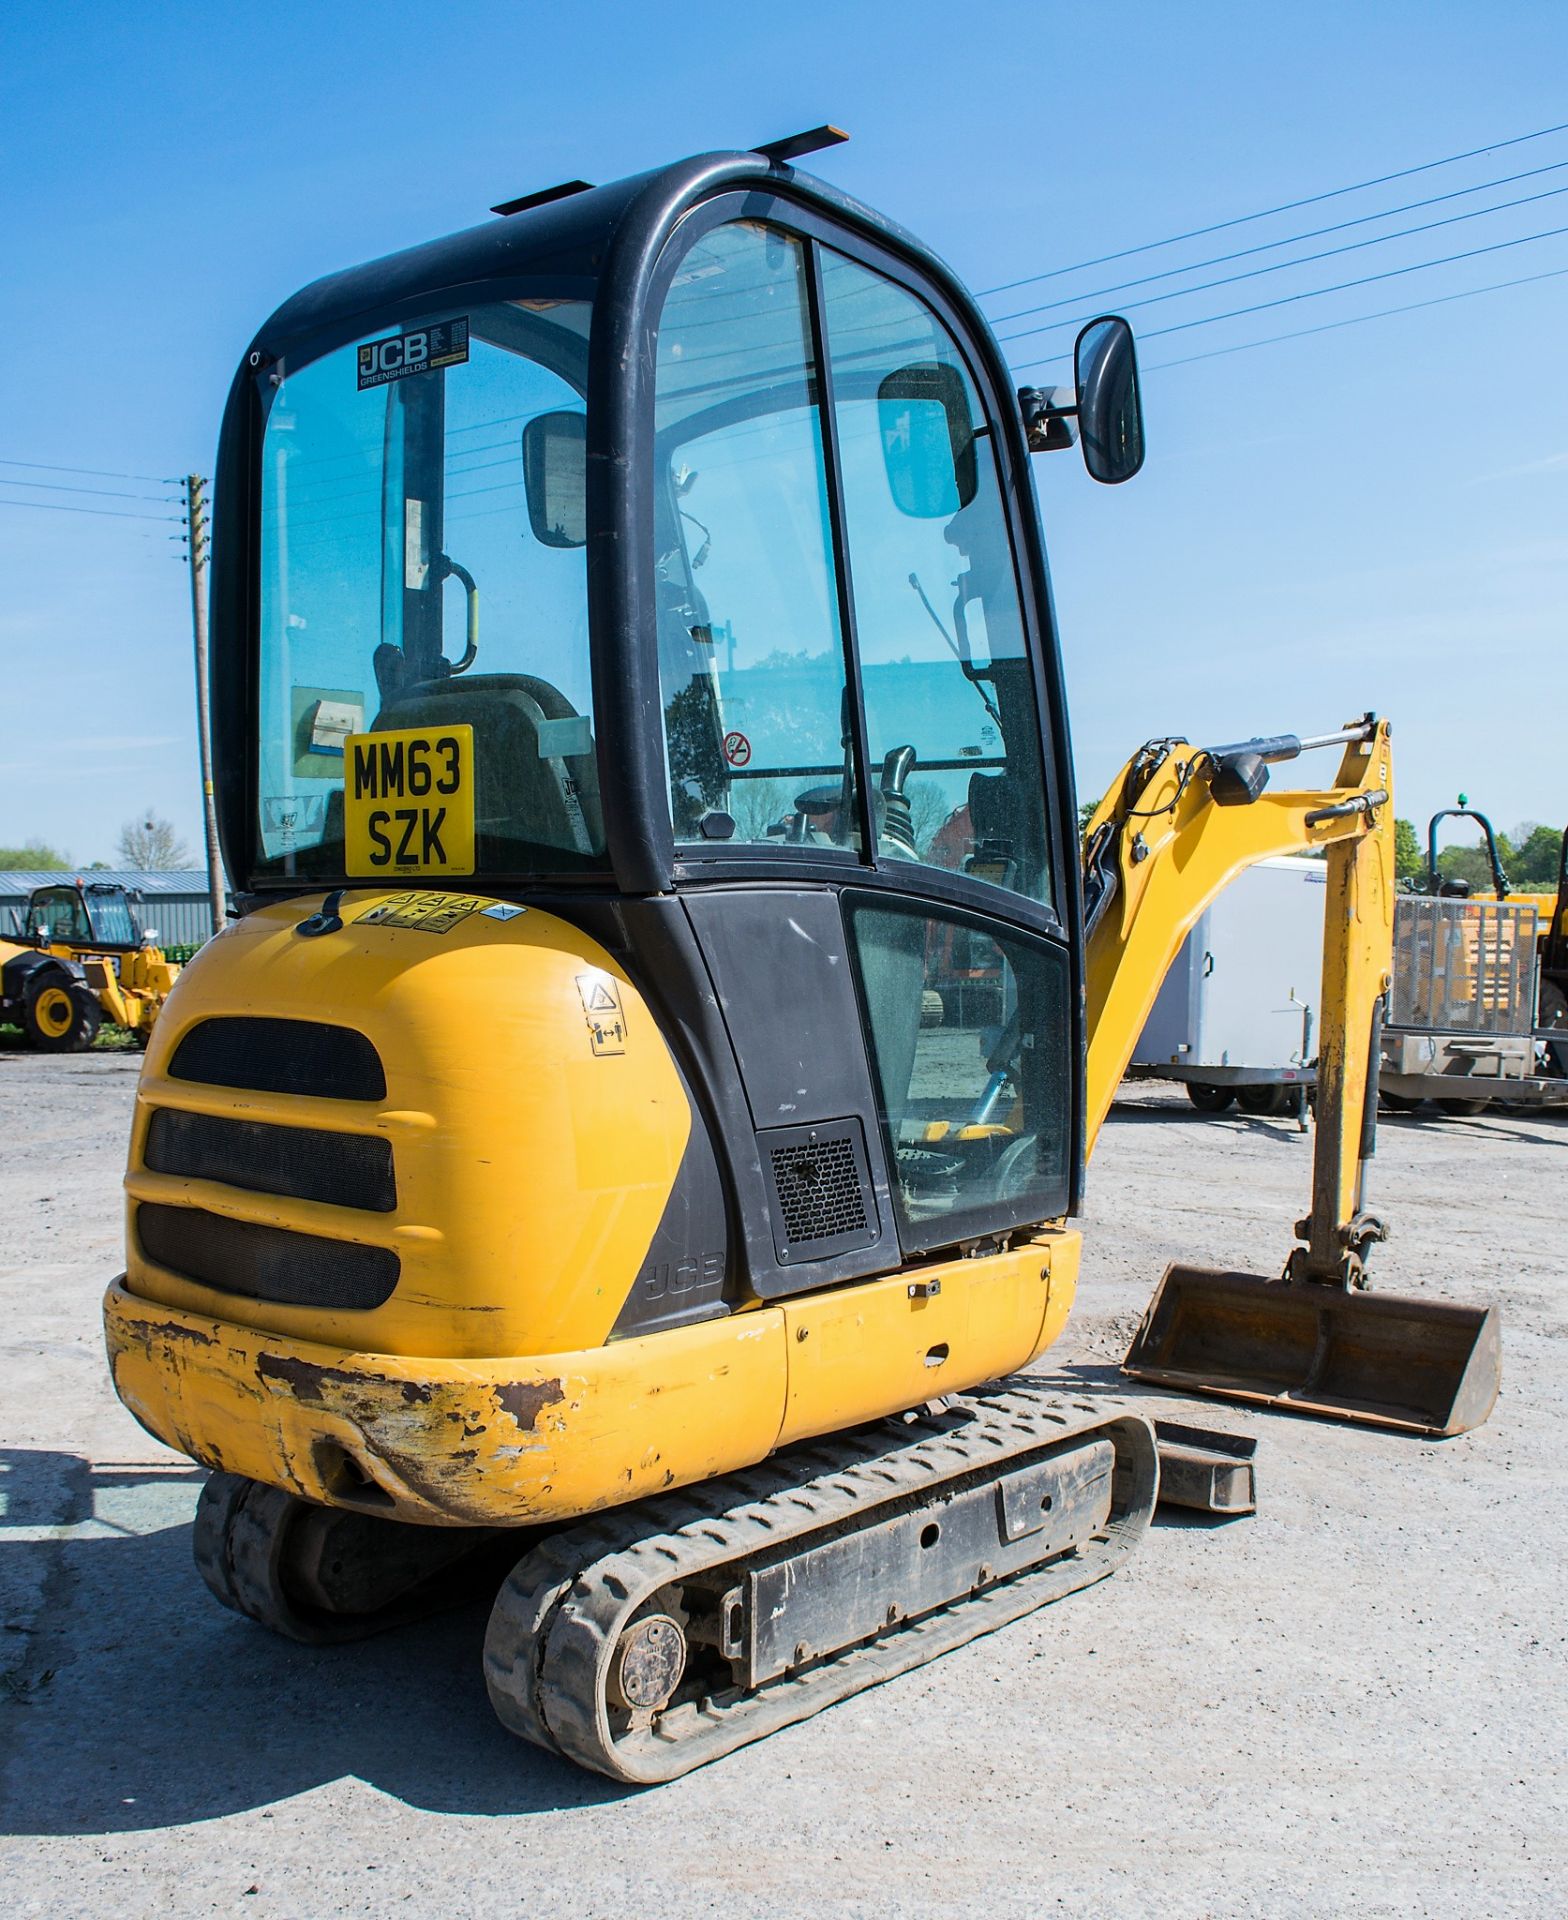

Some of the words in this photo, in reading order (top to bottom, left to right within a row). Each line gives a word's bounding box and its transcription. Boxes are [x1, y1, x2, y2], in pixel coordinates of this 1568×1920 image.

[360, 332, 428, 377] JCB
[360, 361, 428, 387] GREENSHIELDS
[354, 737, 460, 800] MM63
[368, 807, 447, 866] SZK
[644, 1250, 725, 1300] JCB
